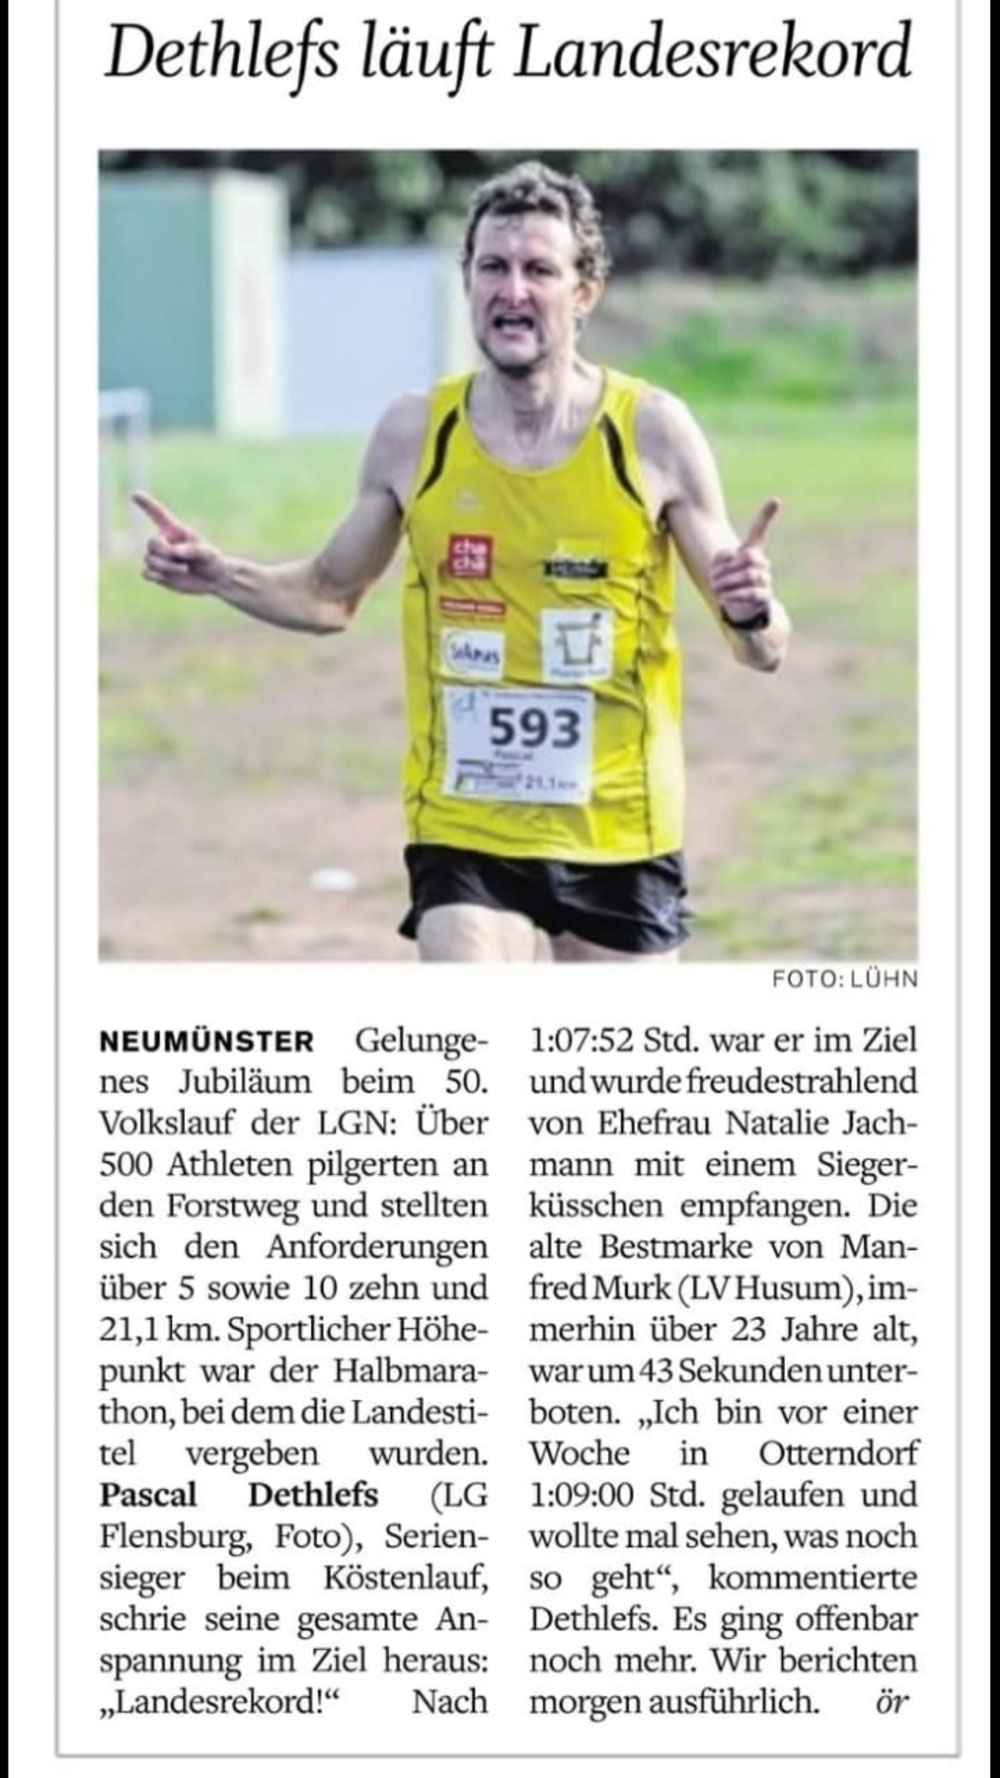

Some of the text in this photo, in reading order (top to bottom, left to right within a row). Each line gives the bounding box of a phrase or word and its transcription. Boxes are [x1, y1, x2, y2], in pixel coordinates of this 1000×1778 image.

[103, 16, 913, 99] Dethlefs läuft Landesrekord
[489, 707, 580, 748] 593
[773, 965, 918, 988] FOTO: LÜHN
[99, 1024, 489, 1061] NEUMÜNSTER Gelunge-
[532, 1024, 917, 1053] 1:07:52 Std. war er im Ziel
[100, 1066, 488, 1095] nes Jubiläum beim 50.
[529, 1065, 918, 1095] und wurde freudestrahlend
[98, 1103, 490, 1136] Volkslauf der LGN: Über
[528, 1107, 918, 1136] von Ehefrau Natalie Jach-
[99, 1149, 489, 1186] 500 Athleten pilgerten an
[529, 1150, 918, 1186] mann mit einem Sieger-
[99, 1190, 489, 1227] den Forstweg und stellten
[529, 1190, 918, 1227] küsschen empfangen. Die
[99, 1231, 489, 1268] sich den Anforderungen
[529, 1231, 918, 1260] alte Bestmarke von Man-
[99, 1272, 489, 1301] über 5 sowie 10 zehn und
[529, 1272, 918, 1309] fred Murk (LV Husum), im-
[99, 1314, 489, 1351] 21,1 km. Sportlicher Höhe-
[529, 1314, 918, 1346] merhin über 23 Jahre alt,
[99, 1355, 489, 1392] punkt war der Halbmara-
[528, 1355, 918, 1384] war um 43 Sekunden unter-
[98, 1396, 489, 1430] thon, bei dem die Landesti-
[528, 1397, 919, 1429] boten. „Ich bin vor einer
[99, 1438, 488, 1475] tel vergeben wurden.
[528, 1438, 922, 1466] Woche in Otterndorf
[100, 1479, 488, 1515] Pascal Dethlefs (LG
[531, 1479, 918, 1517] 1:09:00 Std. gelaufen und
[100, 1521, 489, 1558] Flensburg, Foto), Serien-
[528, 1520, 919, 1554] wollte mal sehen, was noch
[99, 1562, 489, 1599] sieger beim Köstenlauf,
[529, 1562, 918, 1599] so geht“, kommentierte
[99, 1603, 489, 1641] schrie seine gesamte An-
[530, 1603, 919, 1641] Dethlefs. Es ging offenbar
[99, 1645, 488, 1682] spannung im Ziel heraus:
[529, 1645, 918, 1673] noch mehr. Wir berichten
[100, 1686, 489, 1719] „Landesrekord!“ Nach
[529, 1686, 911, 1723] morgen ausführlich. ör
